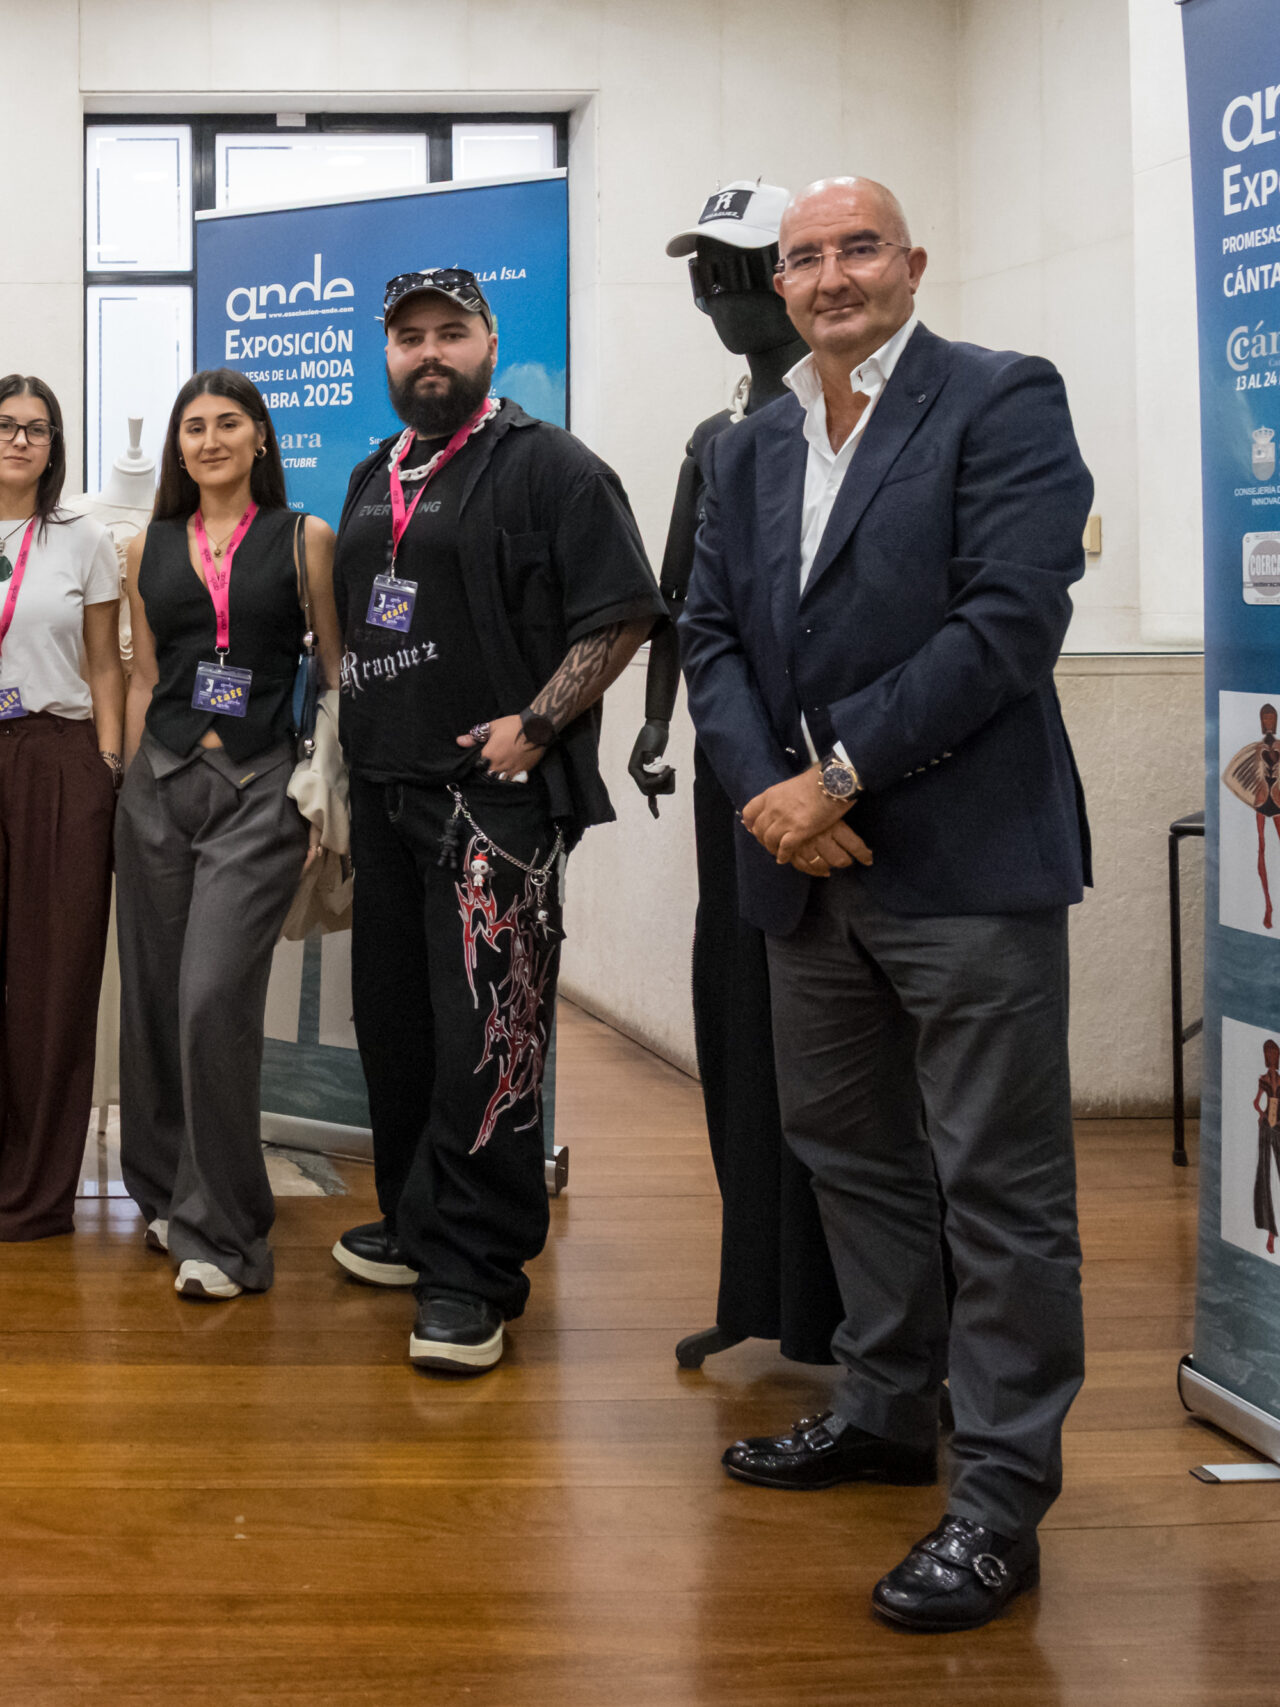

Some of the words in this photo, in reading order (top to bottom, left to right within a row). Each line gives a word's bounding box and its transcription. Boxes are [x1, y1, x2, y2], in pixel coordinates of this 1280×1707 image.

[1223, 164, 1280, 216] EXP
[500, 266, 526, 280] ISLA
[226, 253, 354, 322] ande
[269, 307, 354, 318] www.asociacion-ande.com
[225, 326, 353, 360] EXPOSICIÓN
[272, 369, 284, 381] DE
[286, 369, 298, 380] LA
[301, 359, 354, 379] MODA
[1236, 375, 1247, 391] 13
[1248, 373, 1262, 389] AL
[1264, 371, 1277, 387] 24
[304, 383, 353, 407] 2025
[382, 601, 408, 621] staff
[210, 687, 242, 705] staff
